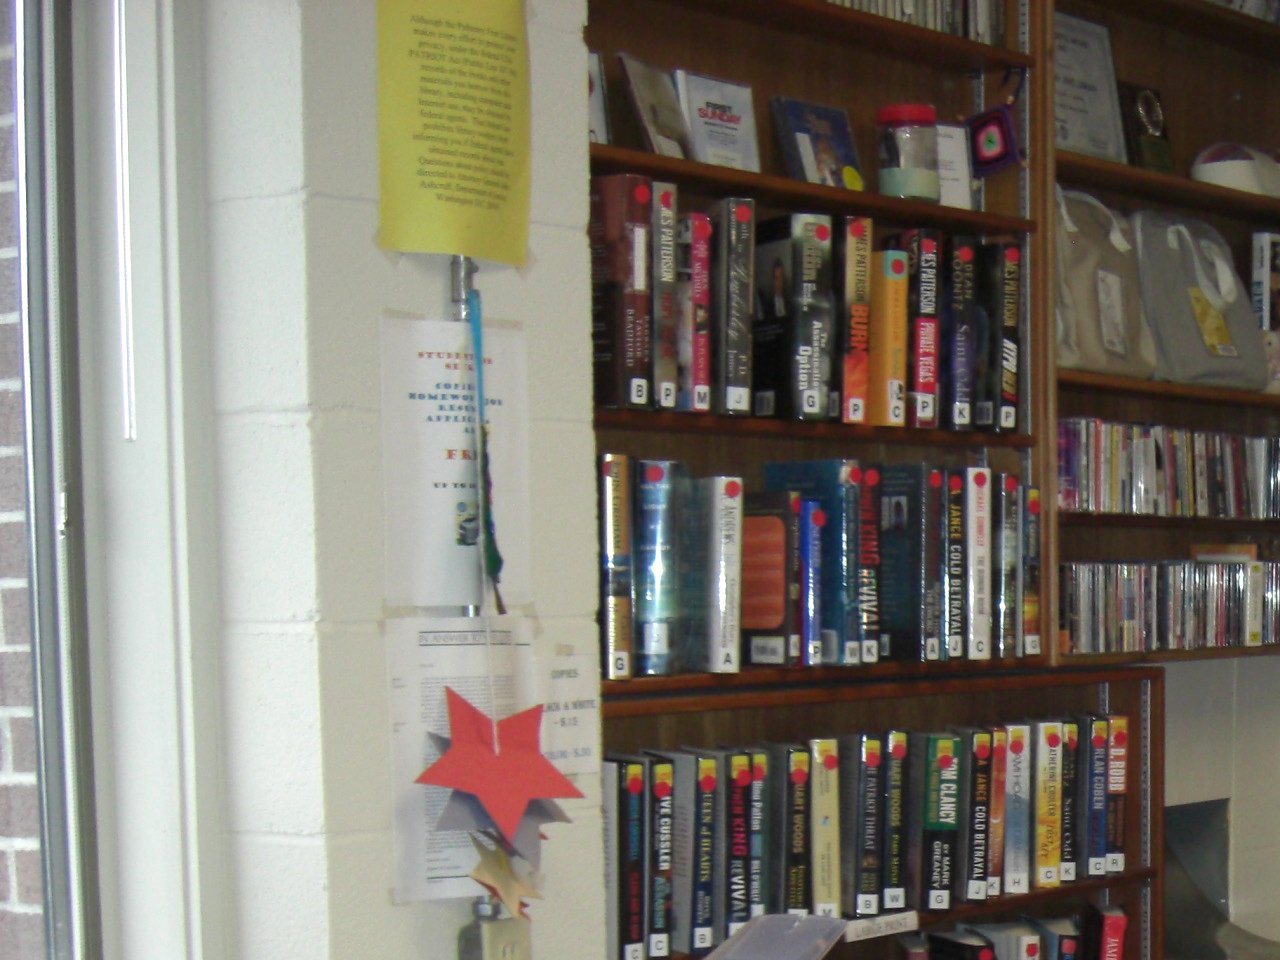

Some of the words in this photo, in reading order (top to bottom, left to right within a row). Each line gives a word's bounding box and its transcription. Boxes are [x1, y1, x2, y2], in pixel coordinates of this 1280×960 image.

[795, 345, 813, 391] Option
[949, 544, 961, 575] COLD
[949, 578, 961, 635] BETRAYAL
[615, 656, 625, 671] G
[975, 640, 985, 653] C
[1048, 748, 1057, 782] ATHERINE
[1108, 760, 1126, 791] ROBB
[938, 782, 956, 824] CLANCY
[1093, 776, 1105, 810] COBEN
[974, 805, 987, 831] COLD
[658, 817, 672, 871] CUSSLER
[972, 833, 986, 880] BETRAYAL
[931, 840, 942, 889] GREANEY
[940, 855, 950, 886] MARK
[1045, 869, 1054, 880] C
[729, 859, 747, 922] REVIVAL
